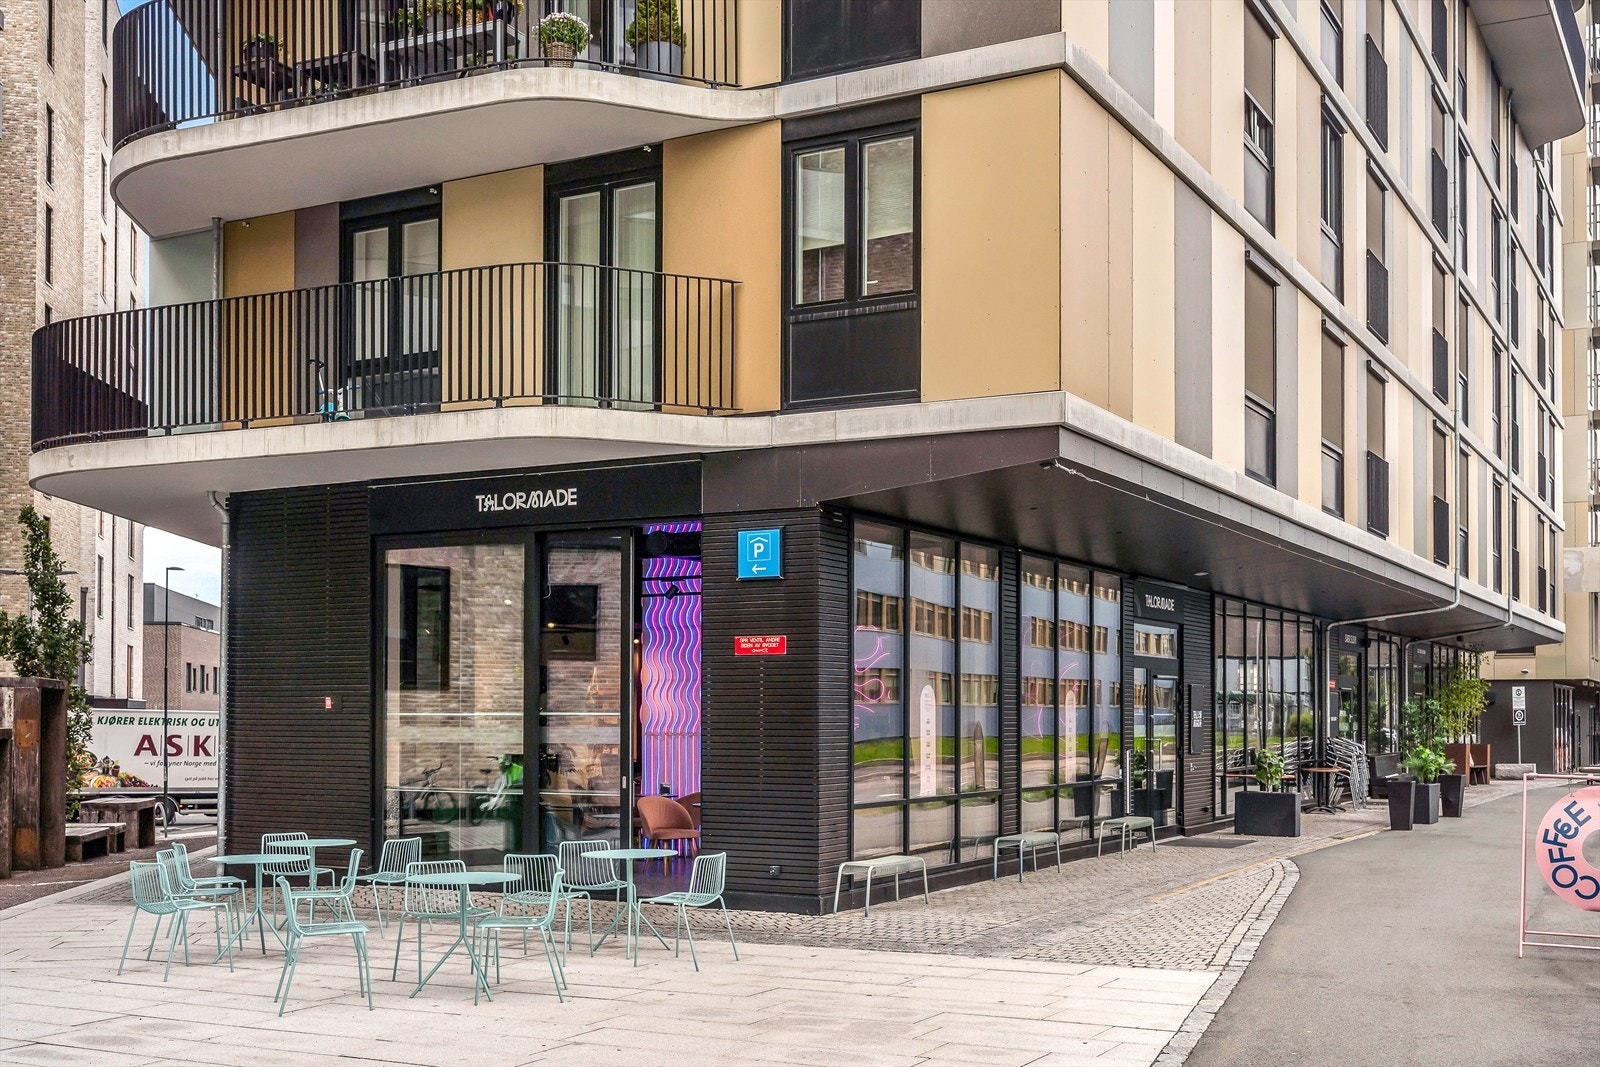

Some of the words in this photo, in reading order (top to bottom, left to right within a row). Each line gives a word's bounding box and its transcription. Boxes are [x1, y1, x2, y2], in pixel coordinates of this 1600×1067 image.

[475, 488, 577, 512] TALORMADE
[753, 543, 764, 558] P
[97, 716, 135, 726] KJØRER
[138, 717, 188, 726] ELEKTRISK
[190, 718, 206, 727] OG
[156, 760, 182, 768] foyner
